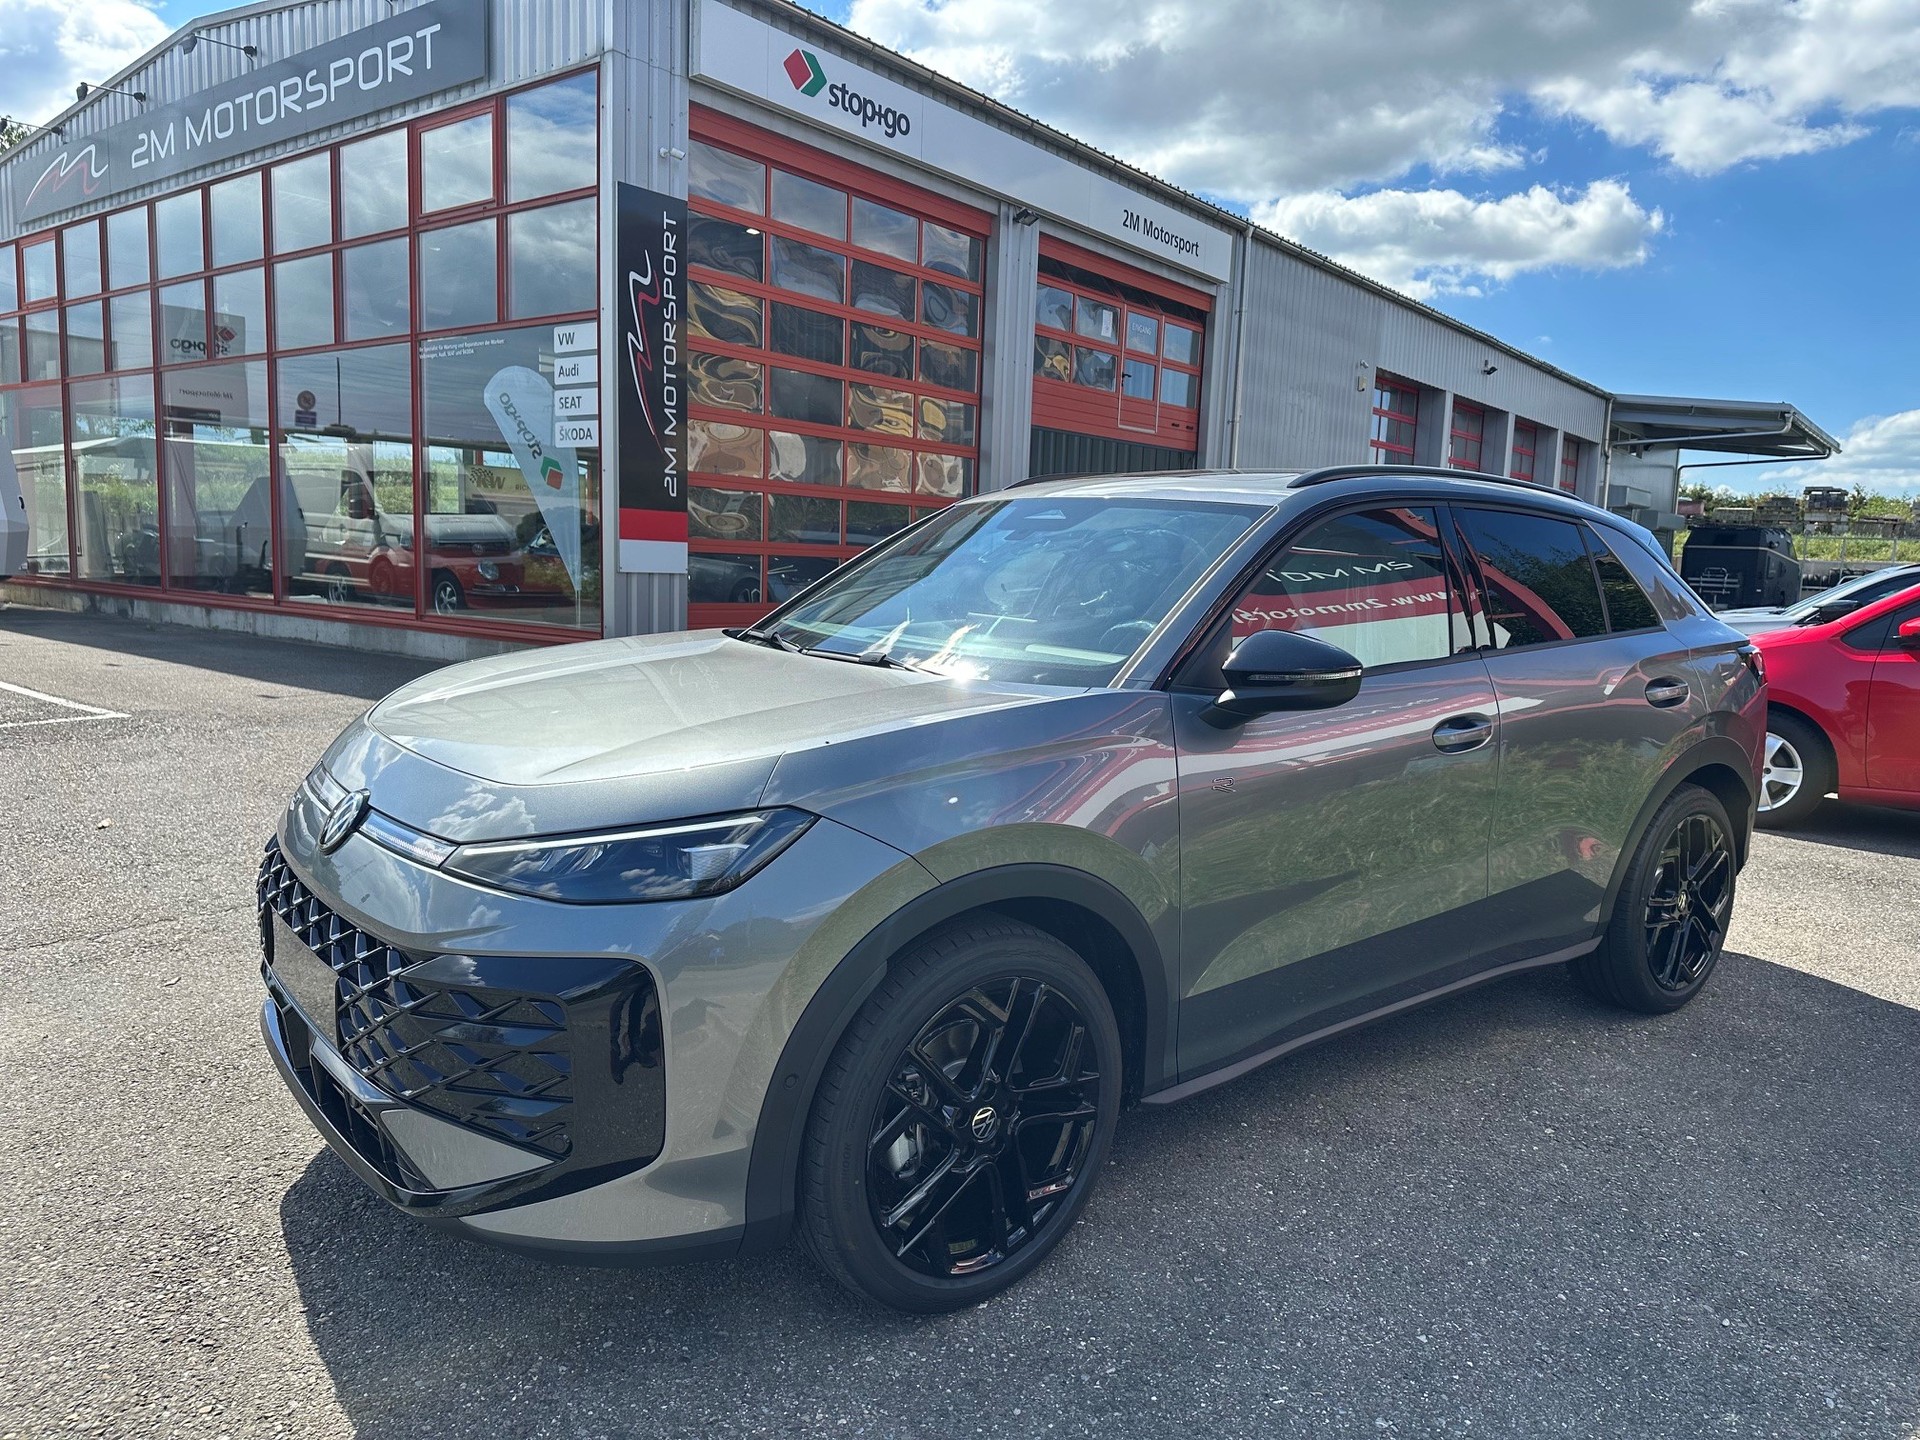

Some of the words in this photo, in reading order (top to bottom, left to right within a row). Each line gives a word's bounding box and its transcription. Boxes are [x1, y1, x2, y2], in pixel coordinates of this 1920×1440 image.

[131, 121, 175, 169] 2M
[185, 23, 442, 150] MOTORSPORT
[828, 83, 911, 138] stop+go
[1122, 209, 1140, 232] 2M
[1143, 218, 1199, 257] Motorsport
[558, 332, 575, 346] VW
[663, 210, 677, 437] MOTORSPORT
[558, 364, 579, 378] Audi
[559, 396, 582, 410] SEAT
[559, 426, 593, 441] ŠKODA
[663, 448, 677, 497] 2M
